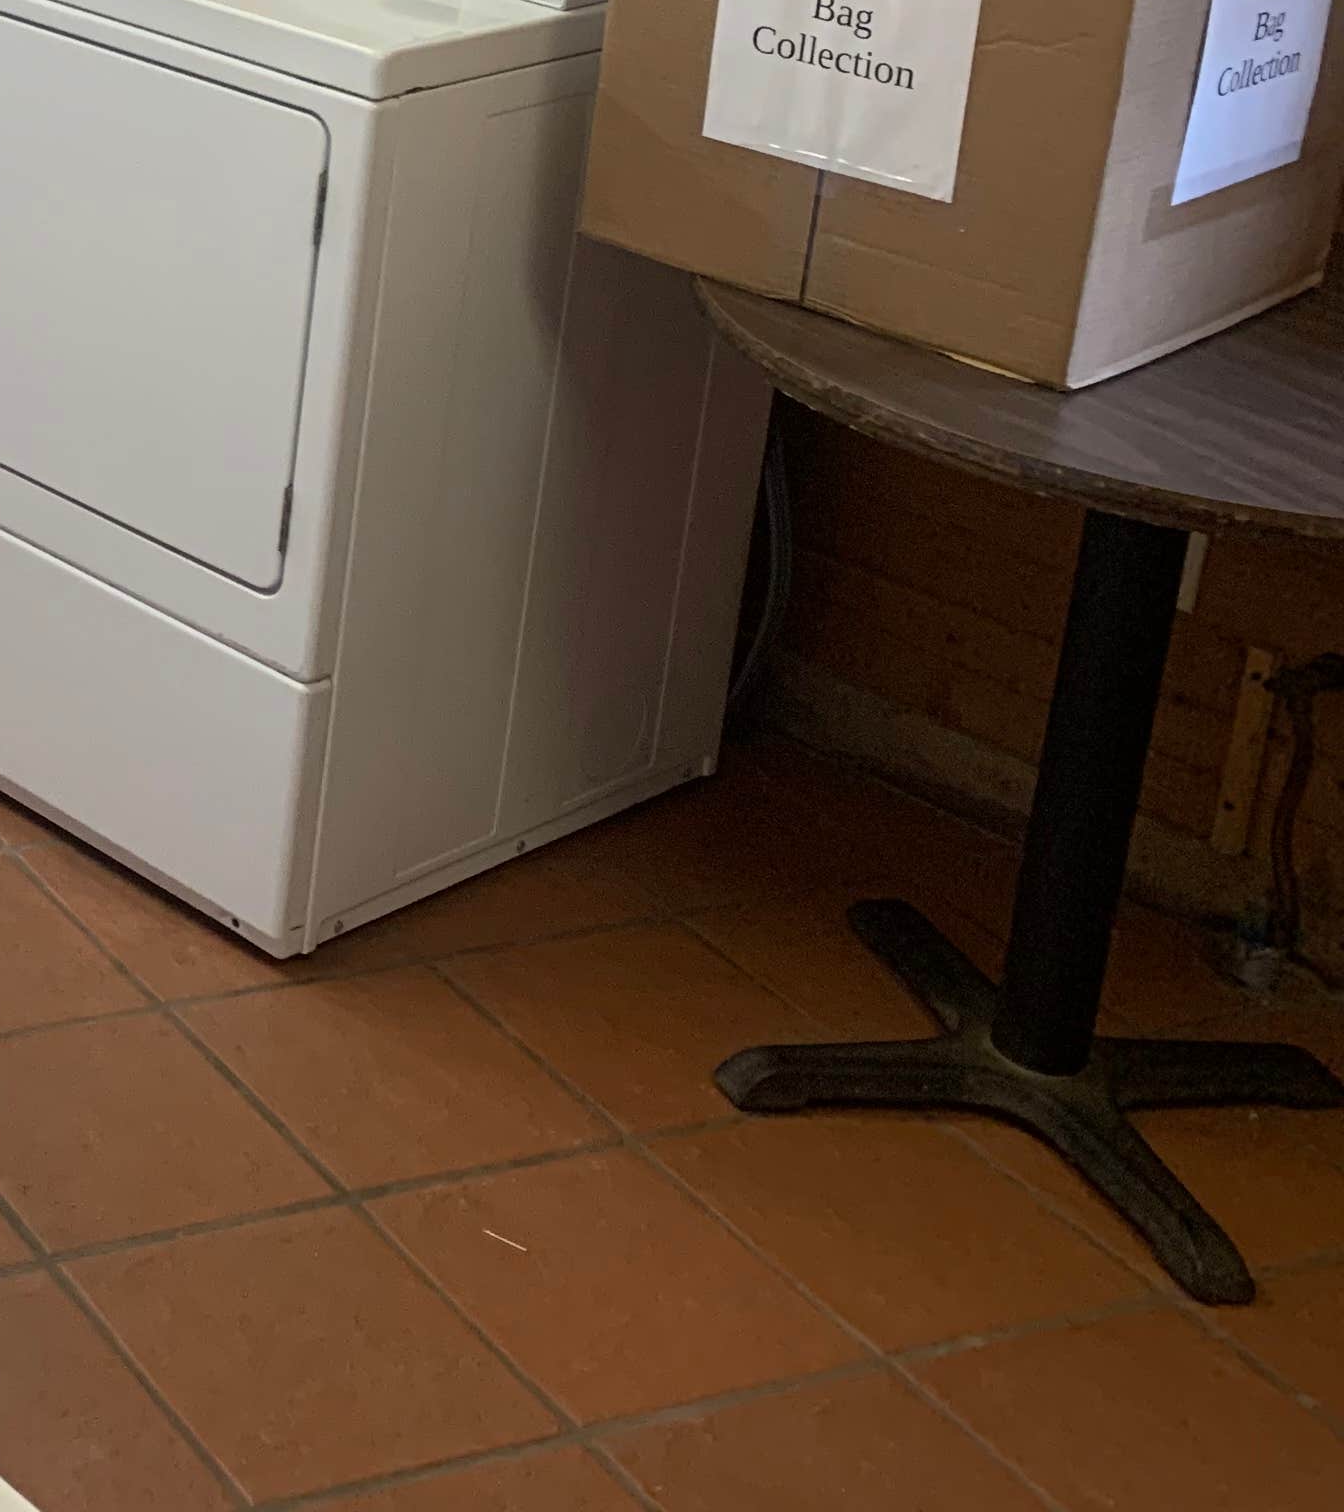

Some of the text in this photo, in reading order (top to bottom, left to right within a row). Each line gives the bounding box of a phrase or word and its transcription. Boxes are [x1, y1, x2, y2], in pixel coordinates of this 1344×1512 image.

[1253, 7, 1286, 43] Bag
[752, 25, 914, 91] Collection
[1216, 48, 1301, 98] Collection
